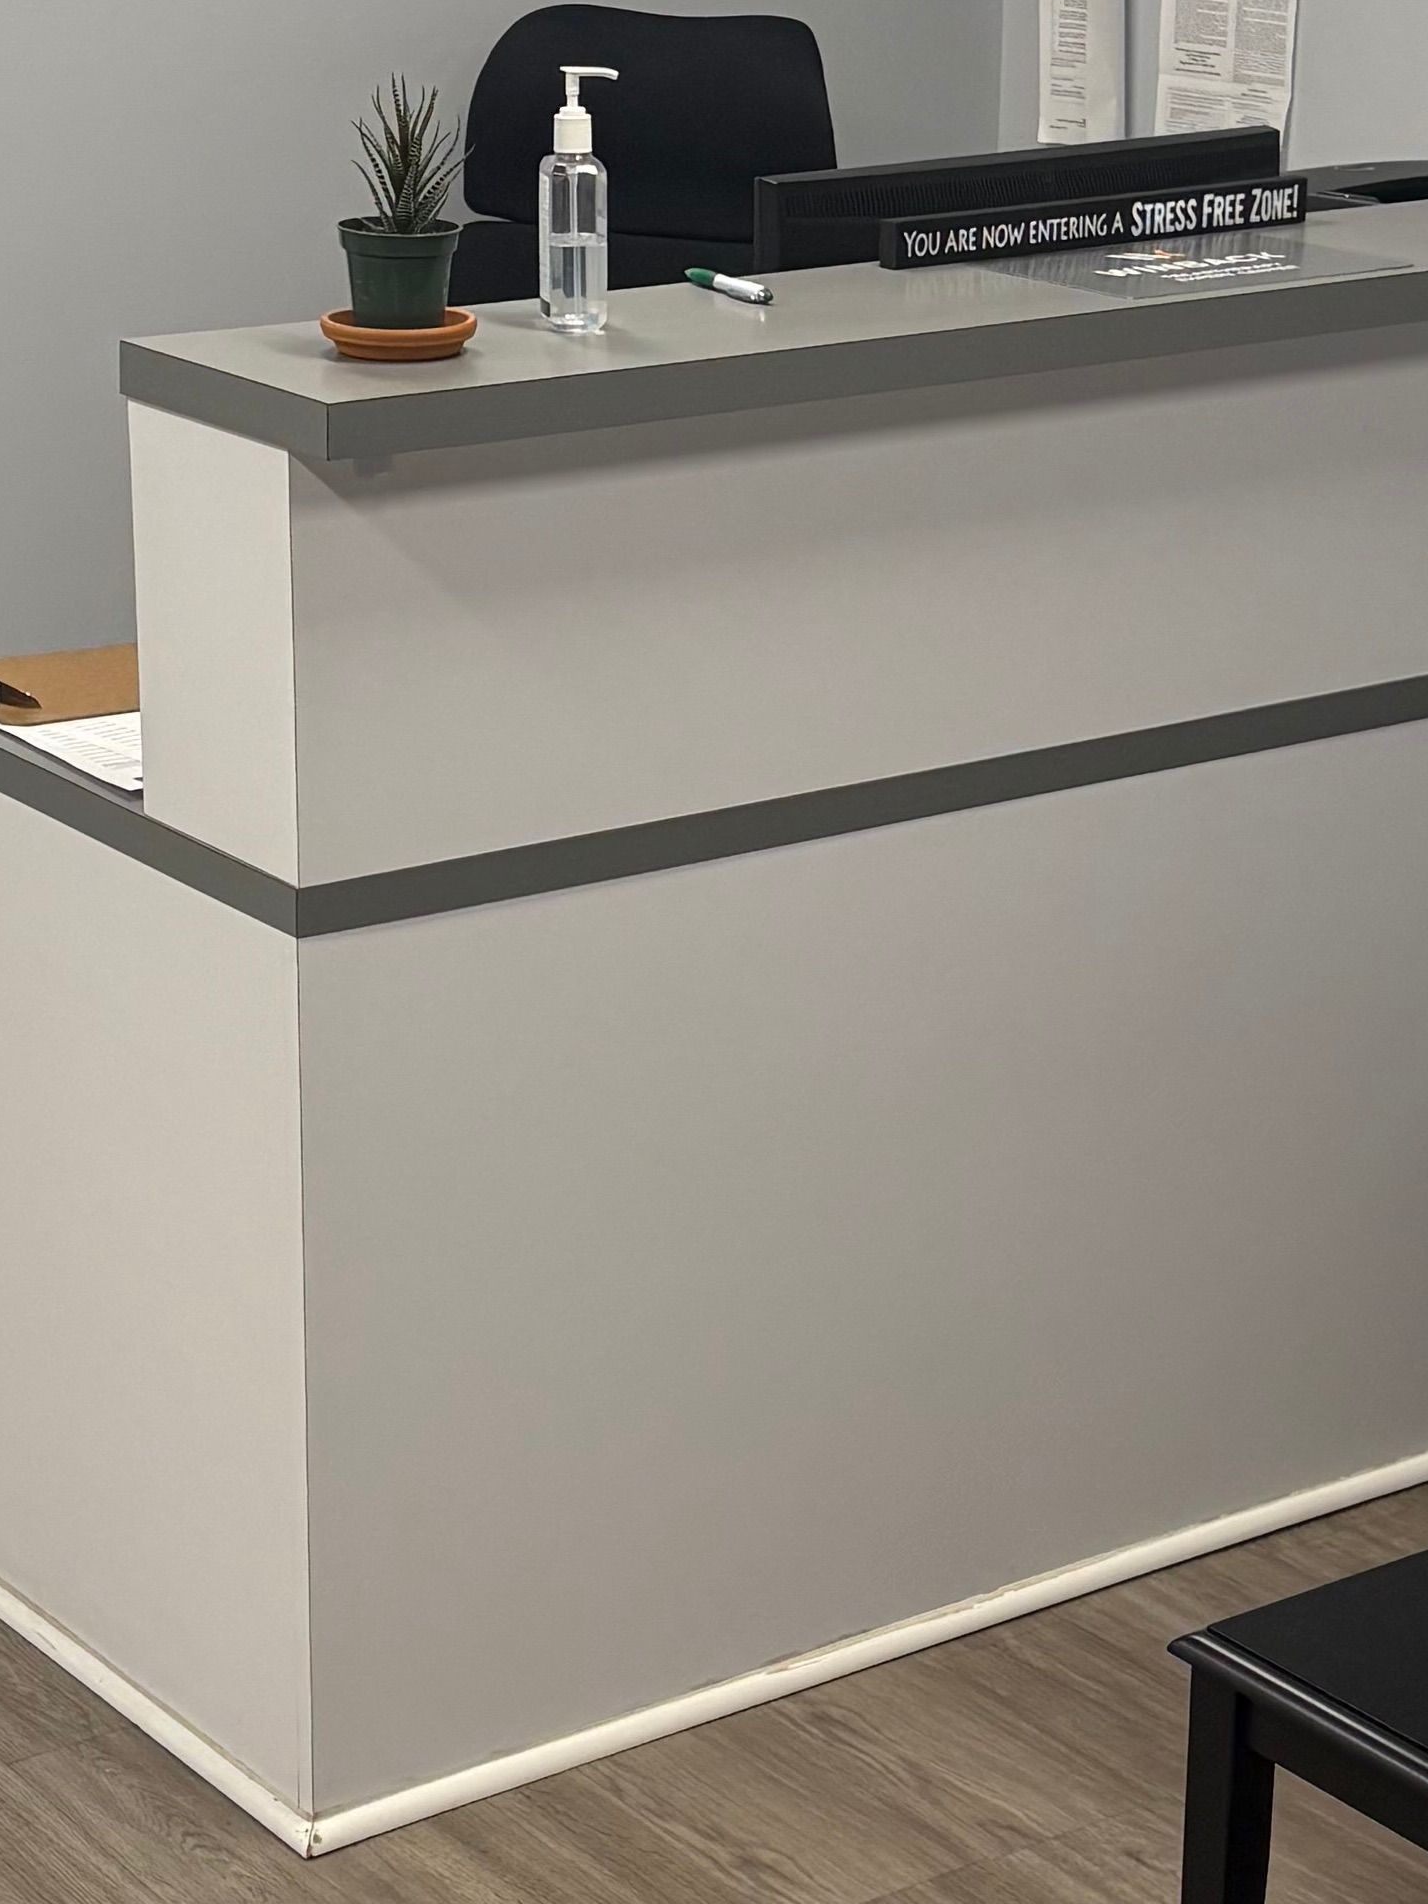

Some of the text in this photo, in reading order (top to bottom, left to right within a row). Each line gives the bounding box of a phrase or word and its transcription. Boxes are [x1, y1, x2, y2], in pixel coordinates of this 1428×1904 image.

[903, 184, 1299, 258] YOU ARE NOW ENTERING A STRESS FREE ZONE!
